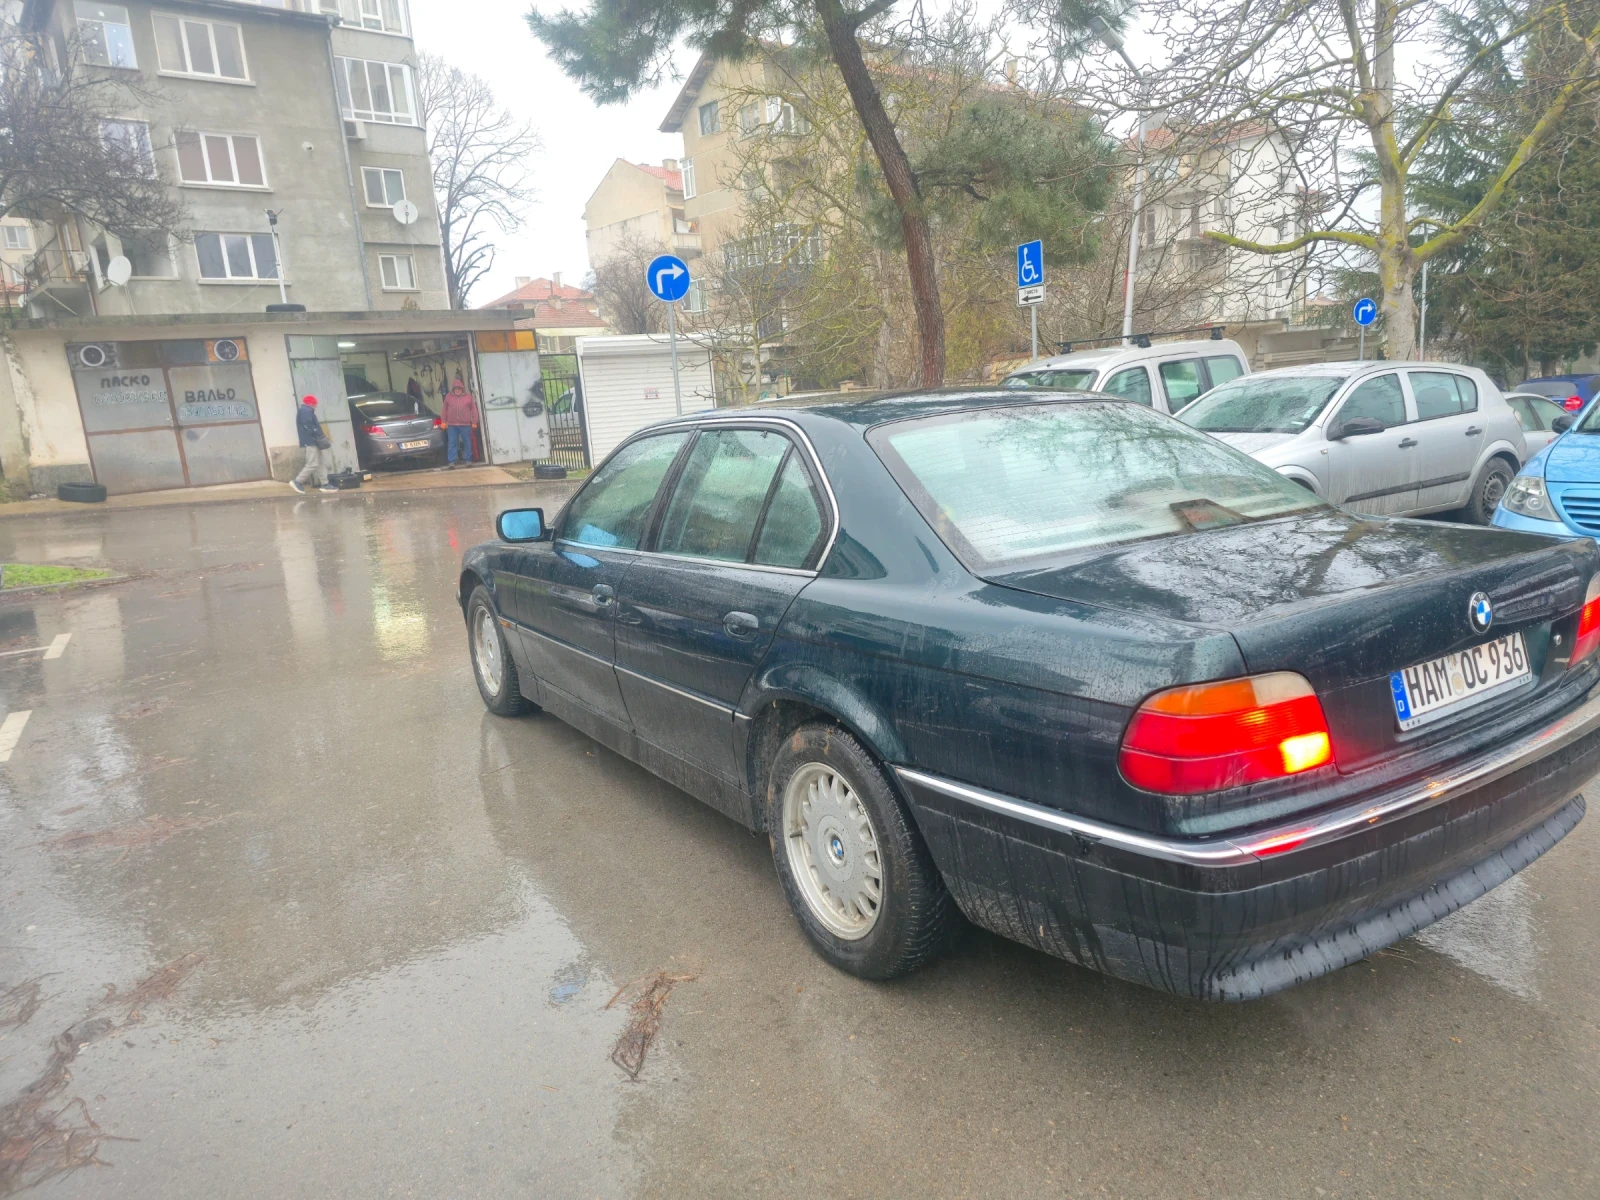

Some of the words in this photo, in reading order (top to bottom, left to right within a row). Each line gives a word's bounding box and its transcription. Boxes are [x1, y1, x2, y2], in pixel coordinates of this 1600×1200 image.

[101, 375, 150, 388] ПАСКО
[184, 388, 236, 402] ВАЛЬО
[1398, 700, 1405, 712] D
[1406, 660, 1452, 708] HAM
[1461, 649, 1488, 689] OC
[1490, 635, 1523, 680] 936
